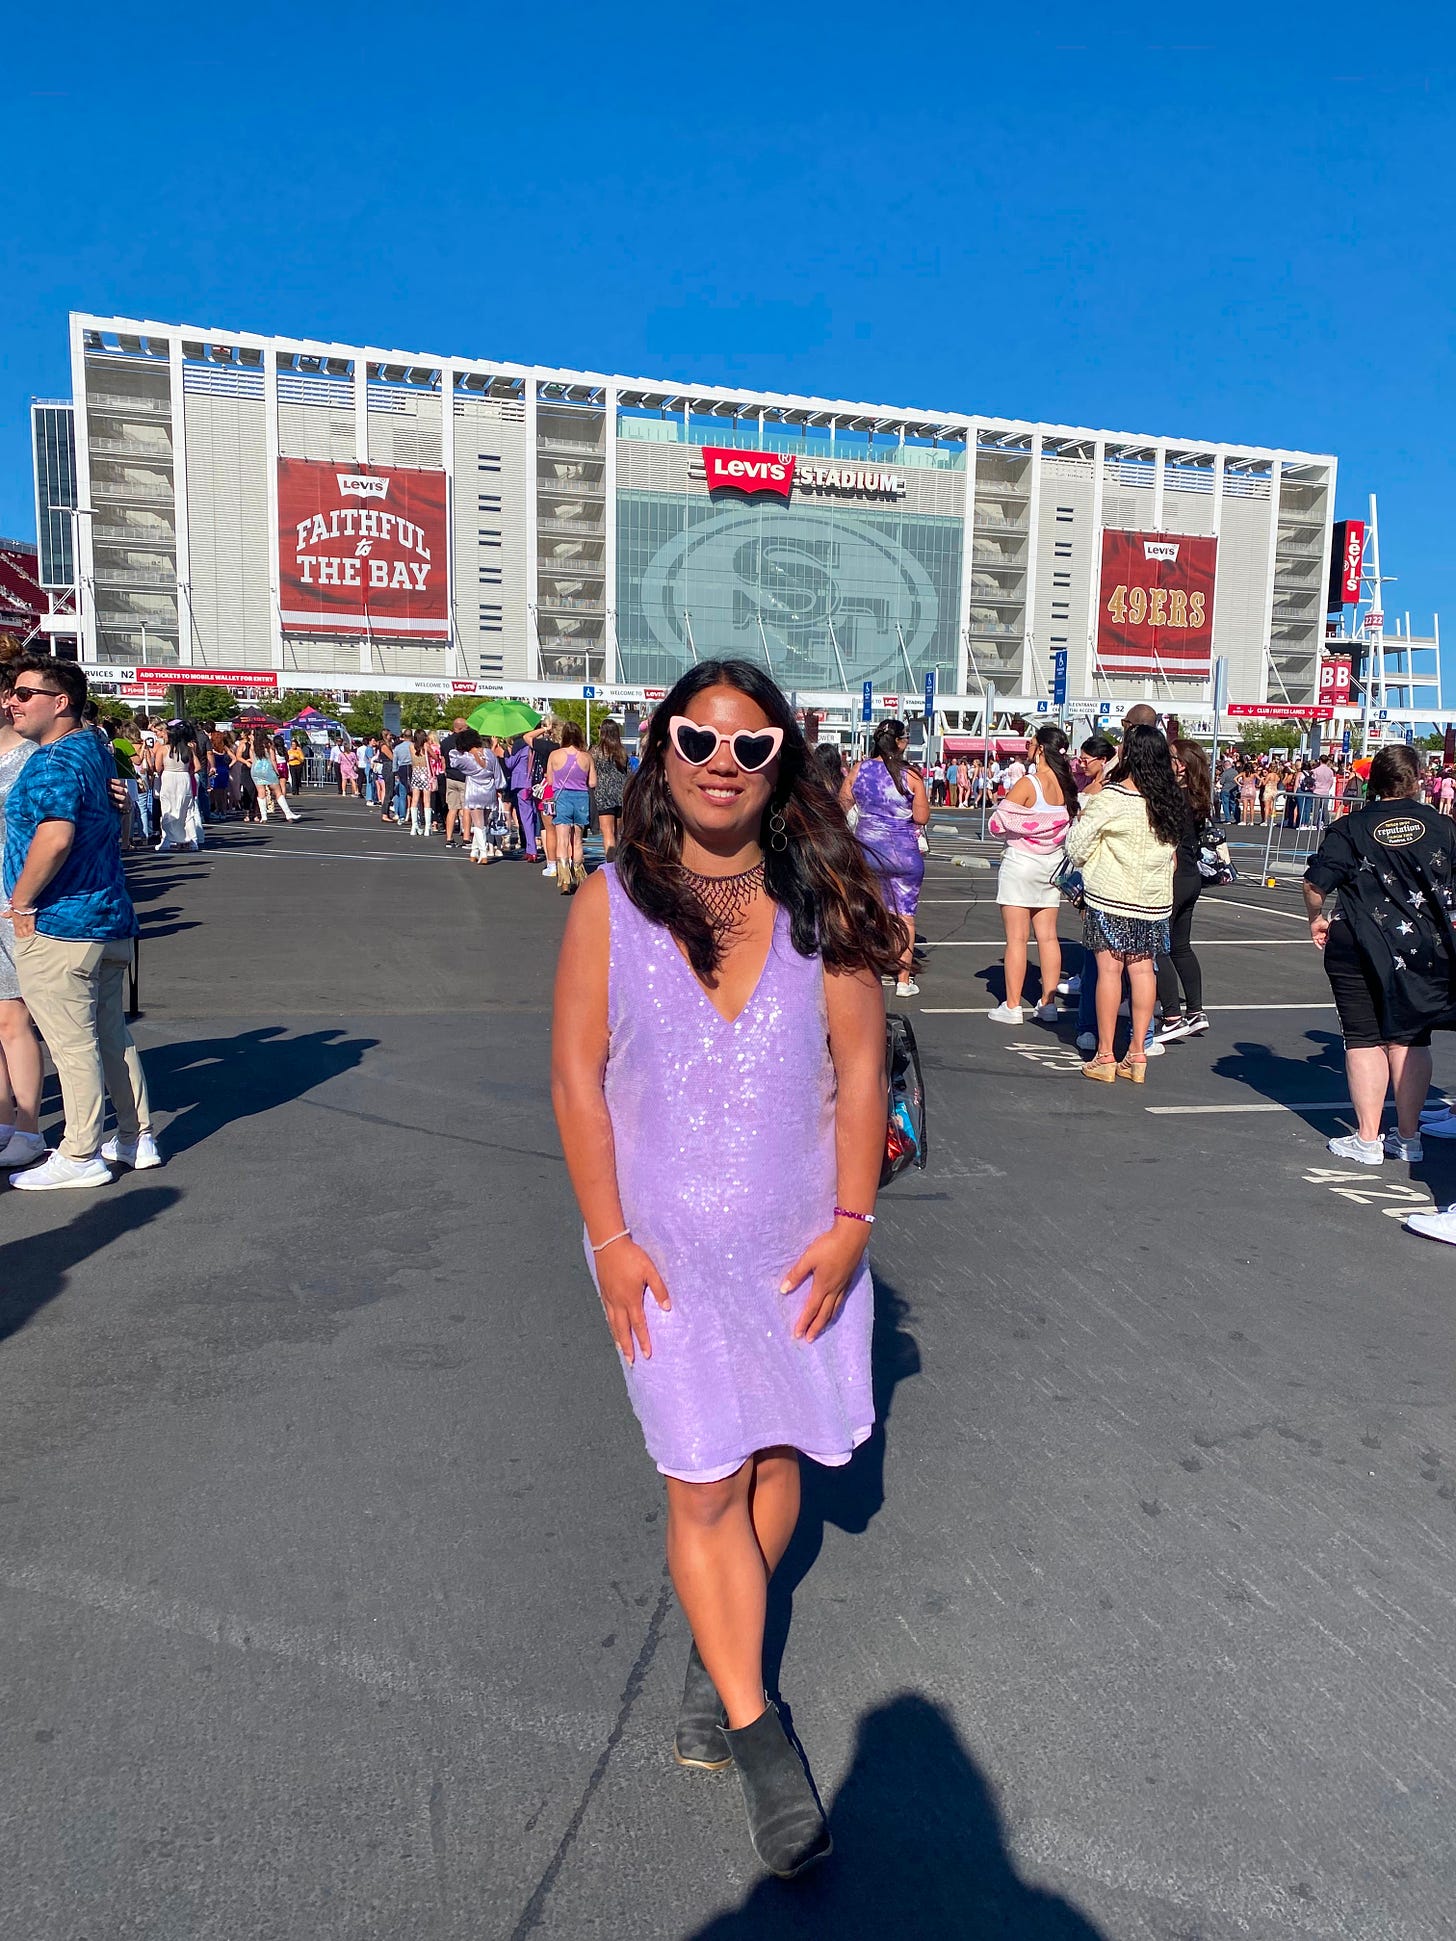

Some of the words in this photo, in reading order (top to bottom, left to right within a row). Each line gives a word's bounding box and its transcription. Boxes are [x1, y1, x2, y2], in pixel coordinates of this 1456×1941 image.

[800, 467, 898, 492] STADIUM
[296, 508, 431, 561] FAITHFUL
[354, 537, 373, 557] to
[296, 555, 360, 586] THE
[368, 559, 432, 591] BAY
[1107, 584, 1206, 629] 49ERS
[1373, 616, 1383, 624] 22
[84, 670, 114, 678] RVICES
[120, 670, 135, 679] N2
[1378, 825, 1421, 836] reputation
